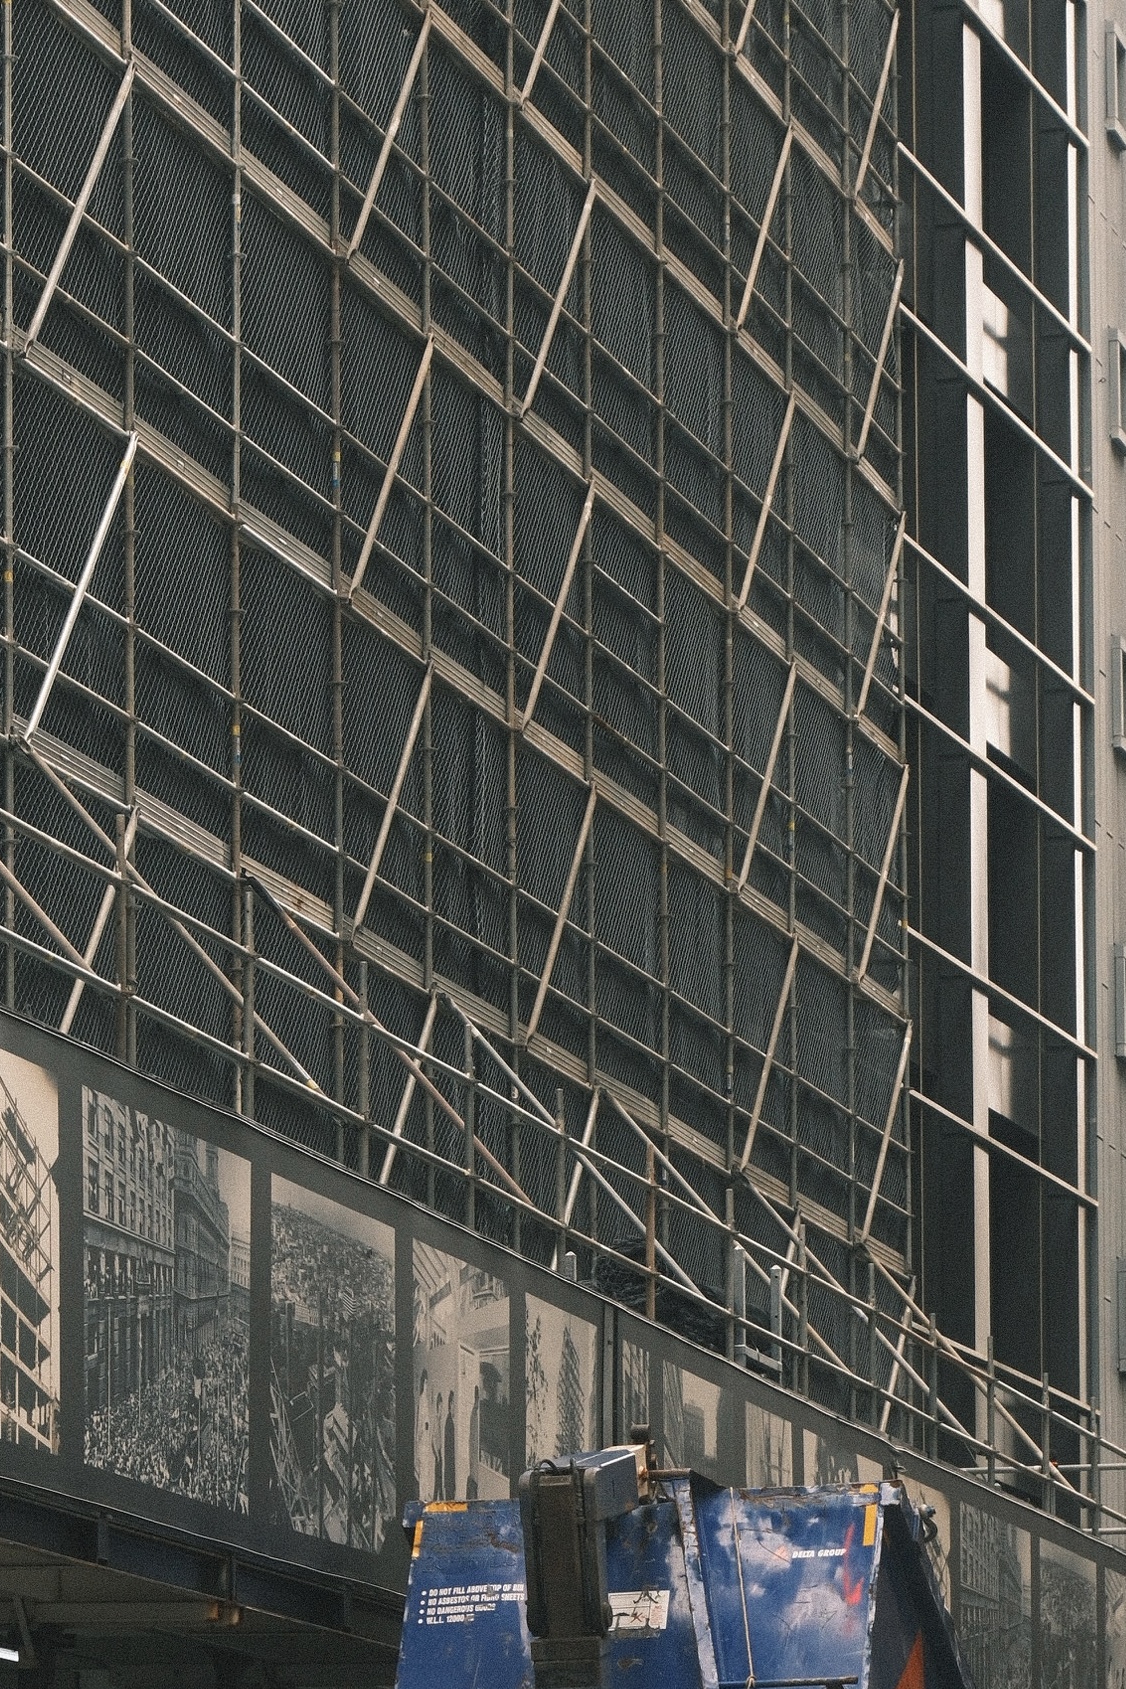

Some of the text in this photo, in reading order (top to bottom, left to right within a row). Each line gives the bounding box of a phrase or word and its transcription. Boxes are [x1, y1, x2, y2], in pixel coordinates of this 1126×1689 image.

[792, 1548, 847, 1558] DELTA GROUP
[429, 1588, 438, 1597] DO
[439, 1587, 452, 1596] NOT
[453, 1586, 466, 1595] FILL
[466, 1584, 488, 1594] ABOVE
[502, 1583, 512, 1592] OF
[427, 1597, 437, 1606] NO
[501, 1592, 525, 1601] SHEETS
[426, 1607, 436, 1616] NO
[437, 1604, 474, 1614] DANGEROUS
